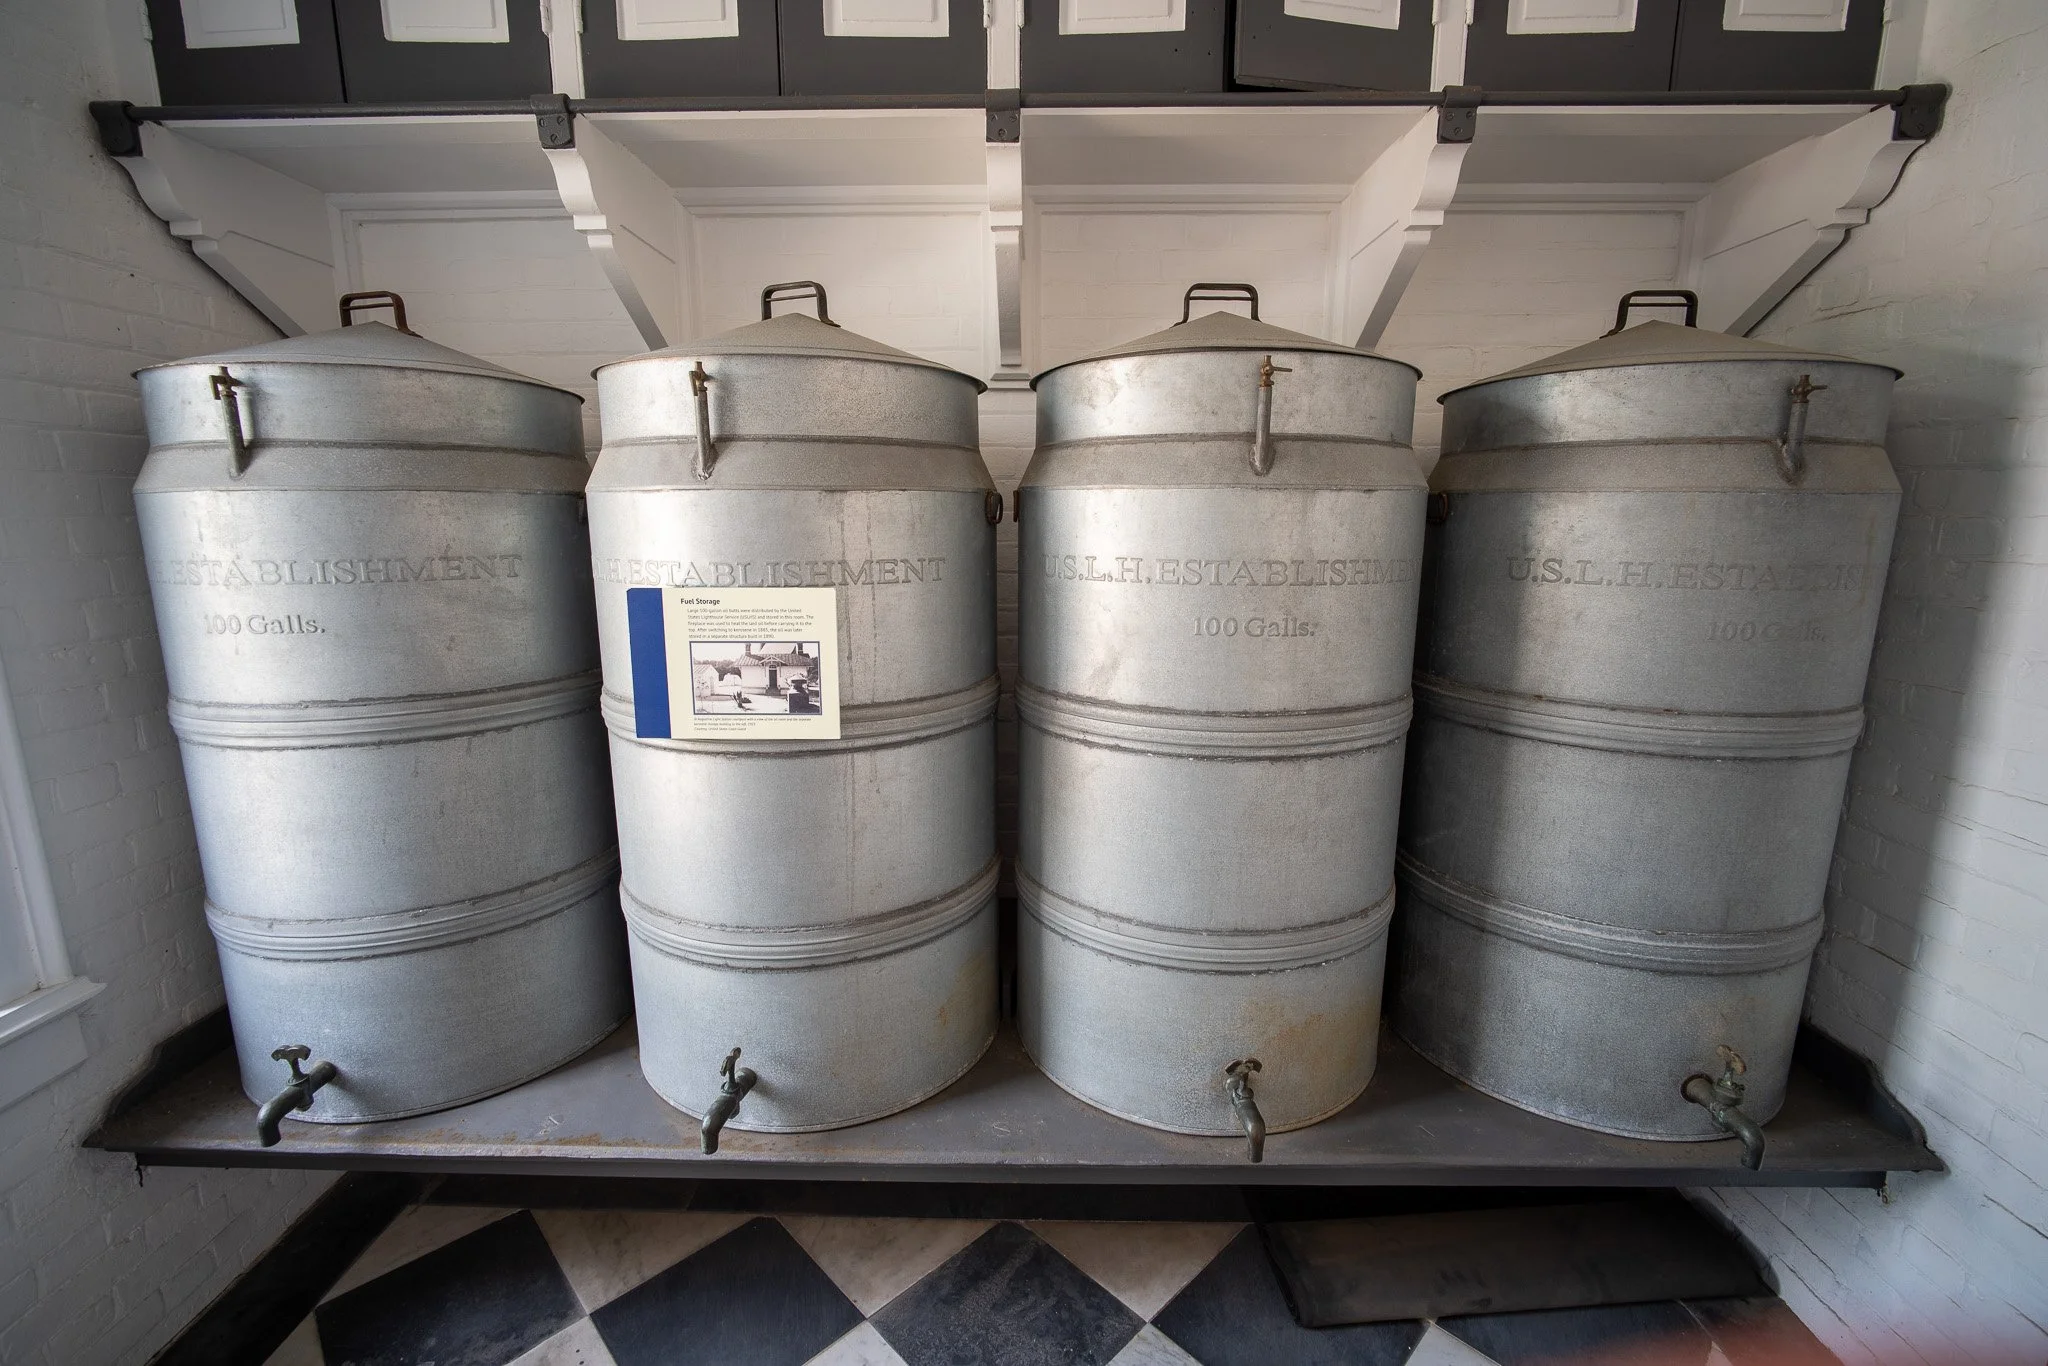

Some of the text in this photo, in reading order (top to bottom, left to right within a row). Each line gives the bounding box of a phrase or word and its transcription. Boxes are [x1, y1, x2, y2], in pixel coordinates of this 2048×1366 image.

[680, 597, 721, 606] Fuel Storage
[203, 613, 326, 635] 100 Galls.
[1194, 617, 1238, 637] 100
